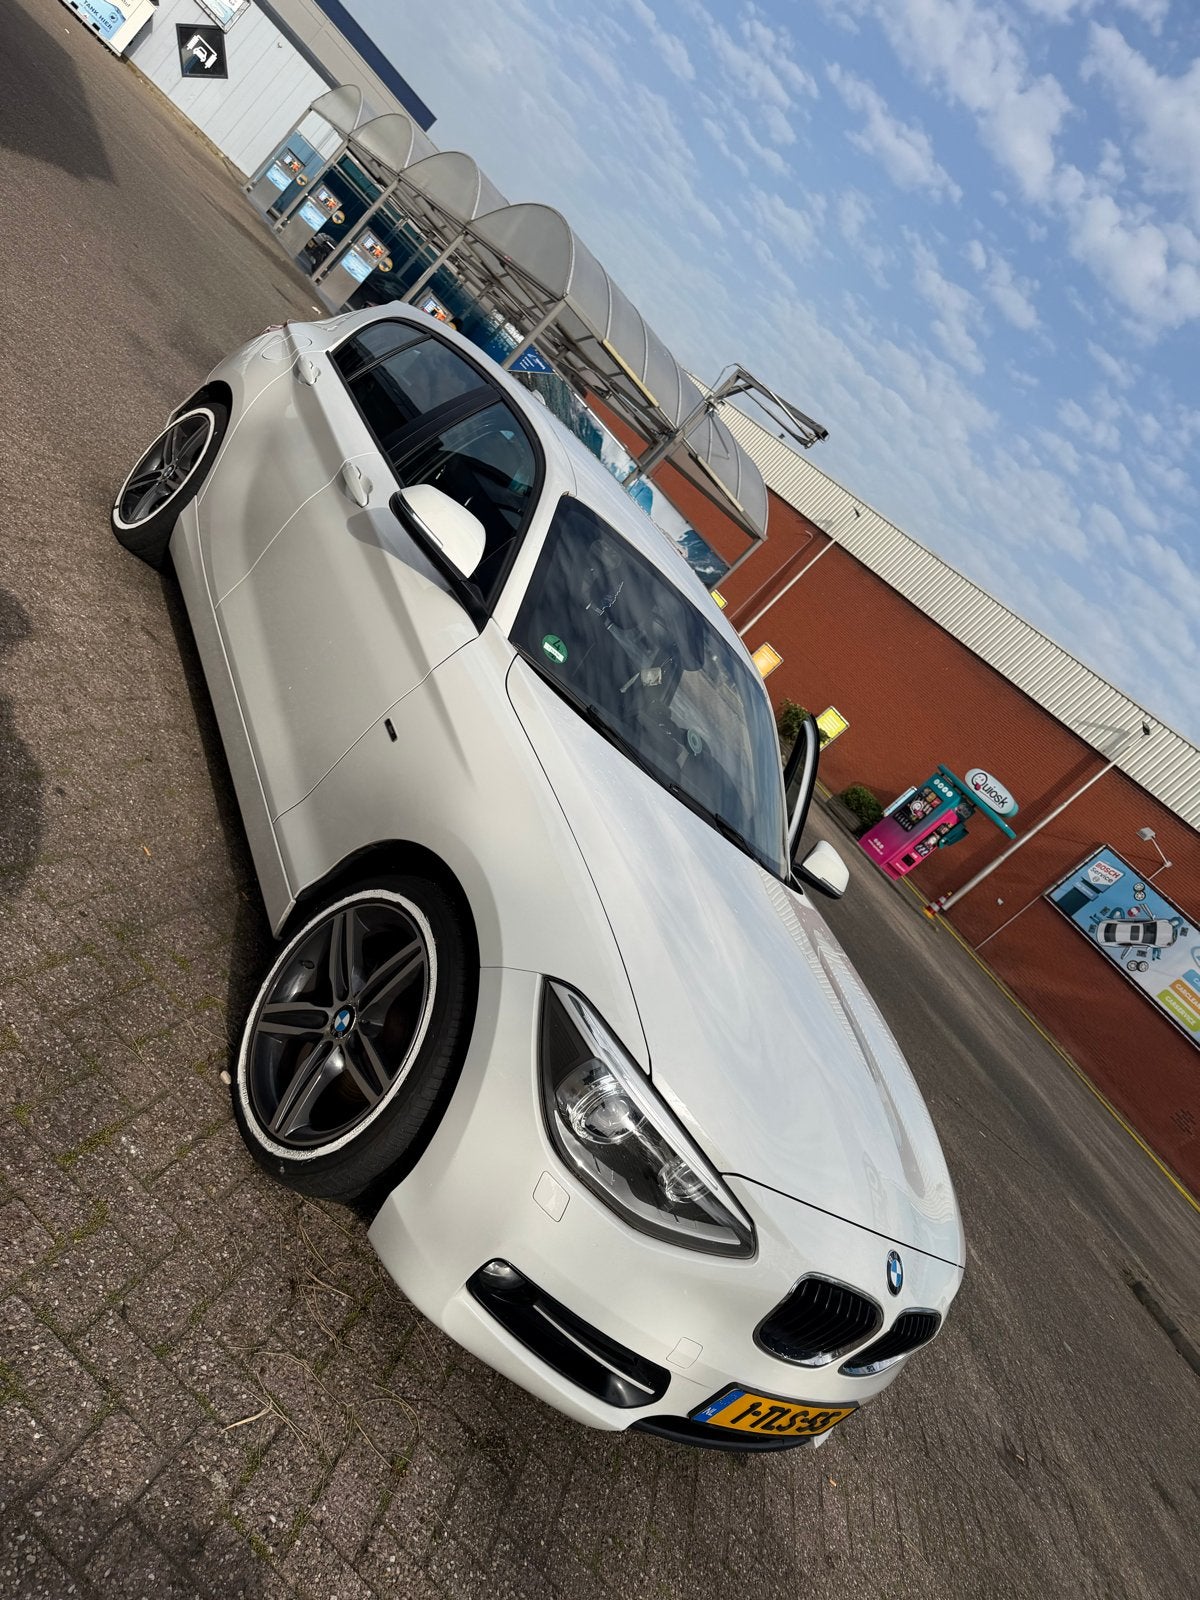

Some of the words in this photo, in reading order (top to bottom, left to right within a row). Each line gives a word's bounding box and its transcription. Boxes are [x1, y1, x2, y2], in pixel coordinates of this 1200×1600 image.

[84, 0, 99, 15] TANK
[98, 15, 113, 30] HIER
[971, 772, 1009, 808] Quiosk
[1090, 867, 1113, 884] Service
[1095, 862, 1121, 878] BOSCH
[1165, 995, 1196, 1026] CARSERVICE
